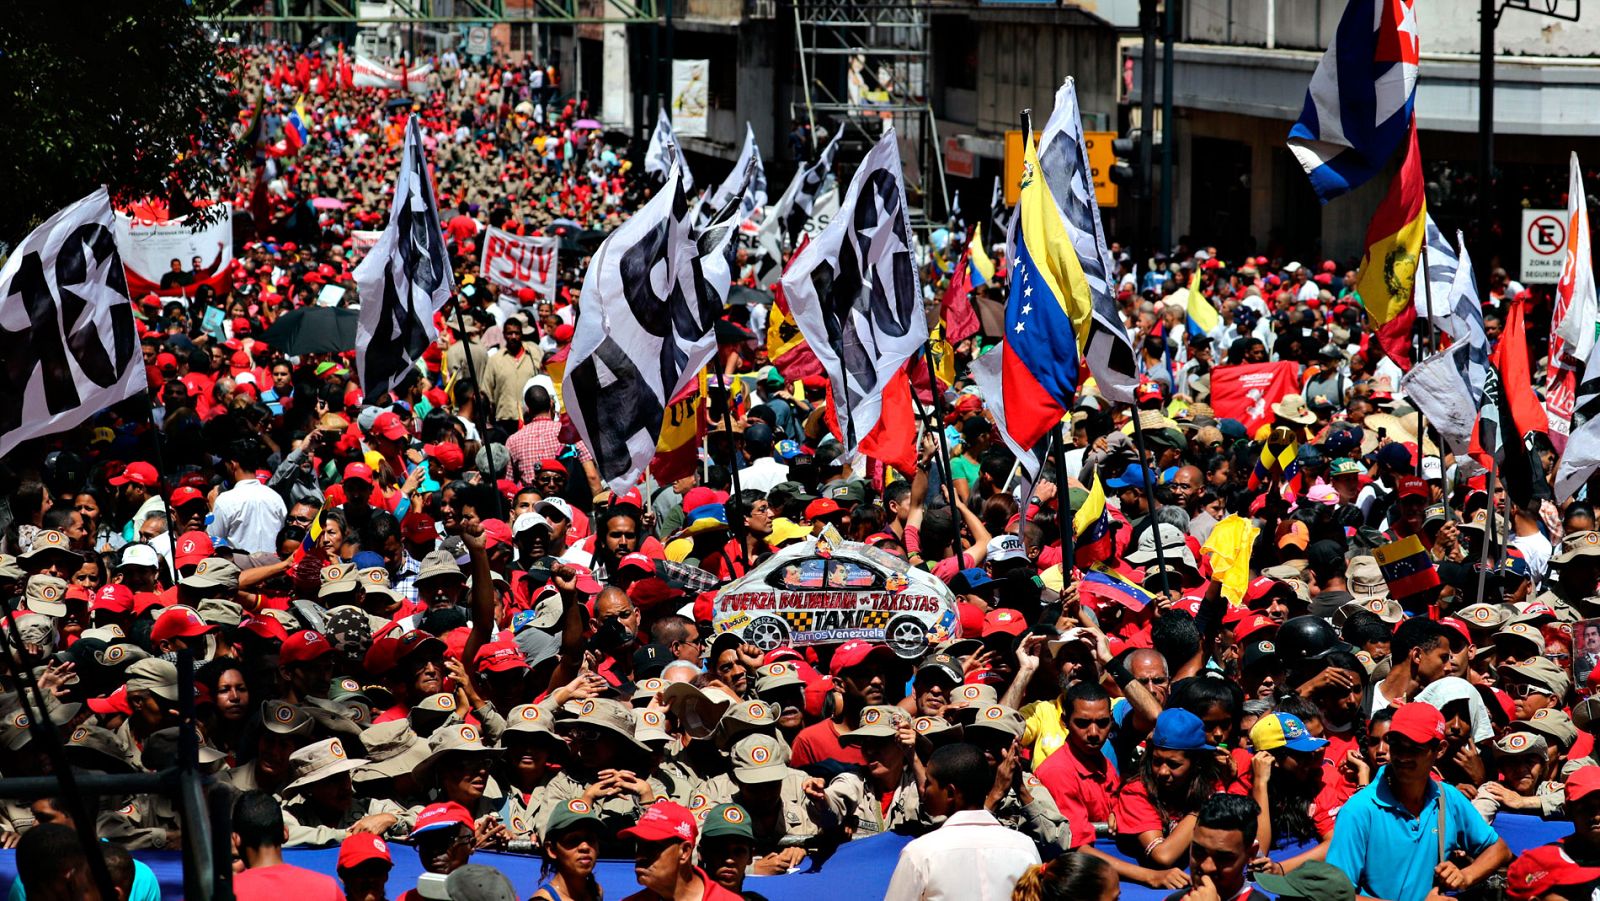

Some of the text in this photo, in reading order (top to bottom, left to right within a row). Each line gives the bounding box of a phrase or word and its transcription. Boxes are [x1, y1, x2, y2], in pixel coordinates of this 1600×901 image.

[484, 235, 553, 284] PSUV
[721, 592, 776, 612] FUERZA
[870, 593, 939, 613] TAXISTAS
[814, 610, 865, 631] TAXI
